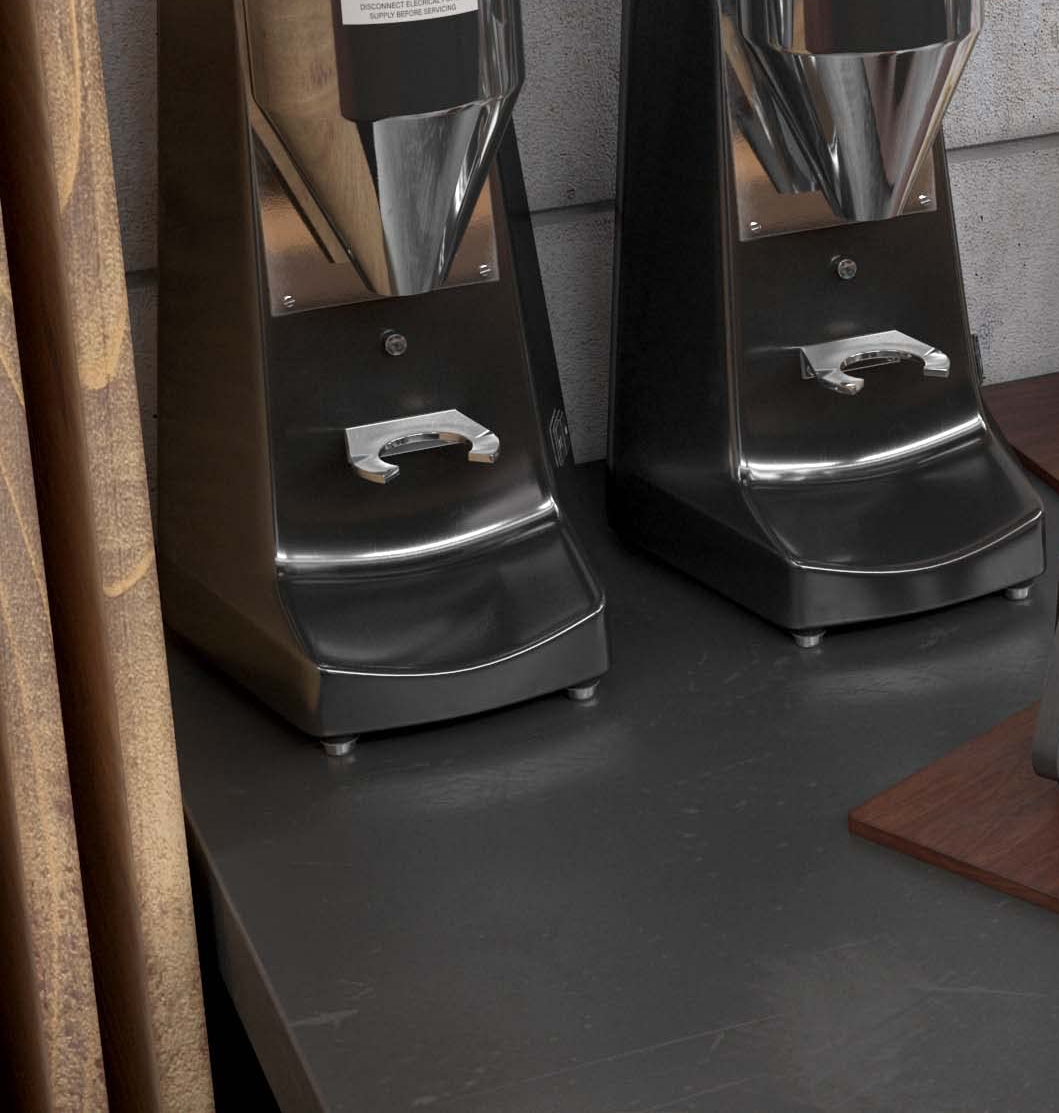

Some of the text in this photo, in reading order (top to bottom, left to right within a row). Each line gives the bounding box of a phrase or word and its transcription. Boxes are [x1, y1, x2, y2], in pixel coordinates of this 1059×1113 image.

[360, 1, 404, 11] DISCONNECT
[369, 3, 457, 20] SUPPLY BEFORE SERVICING
